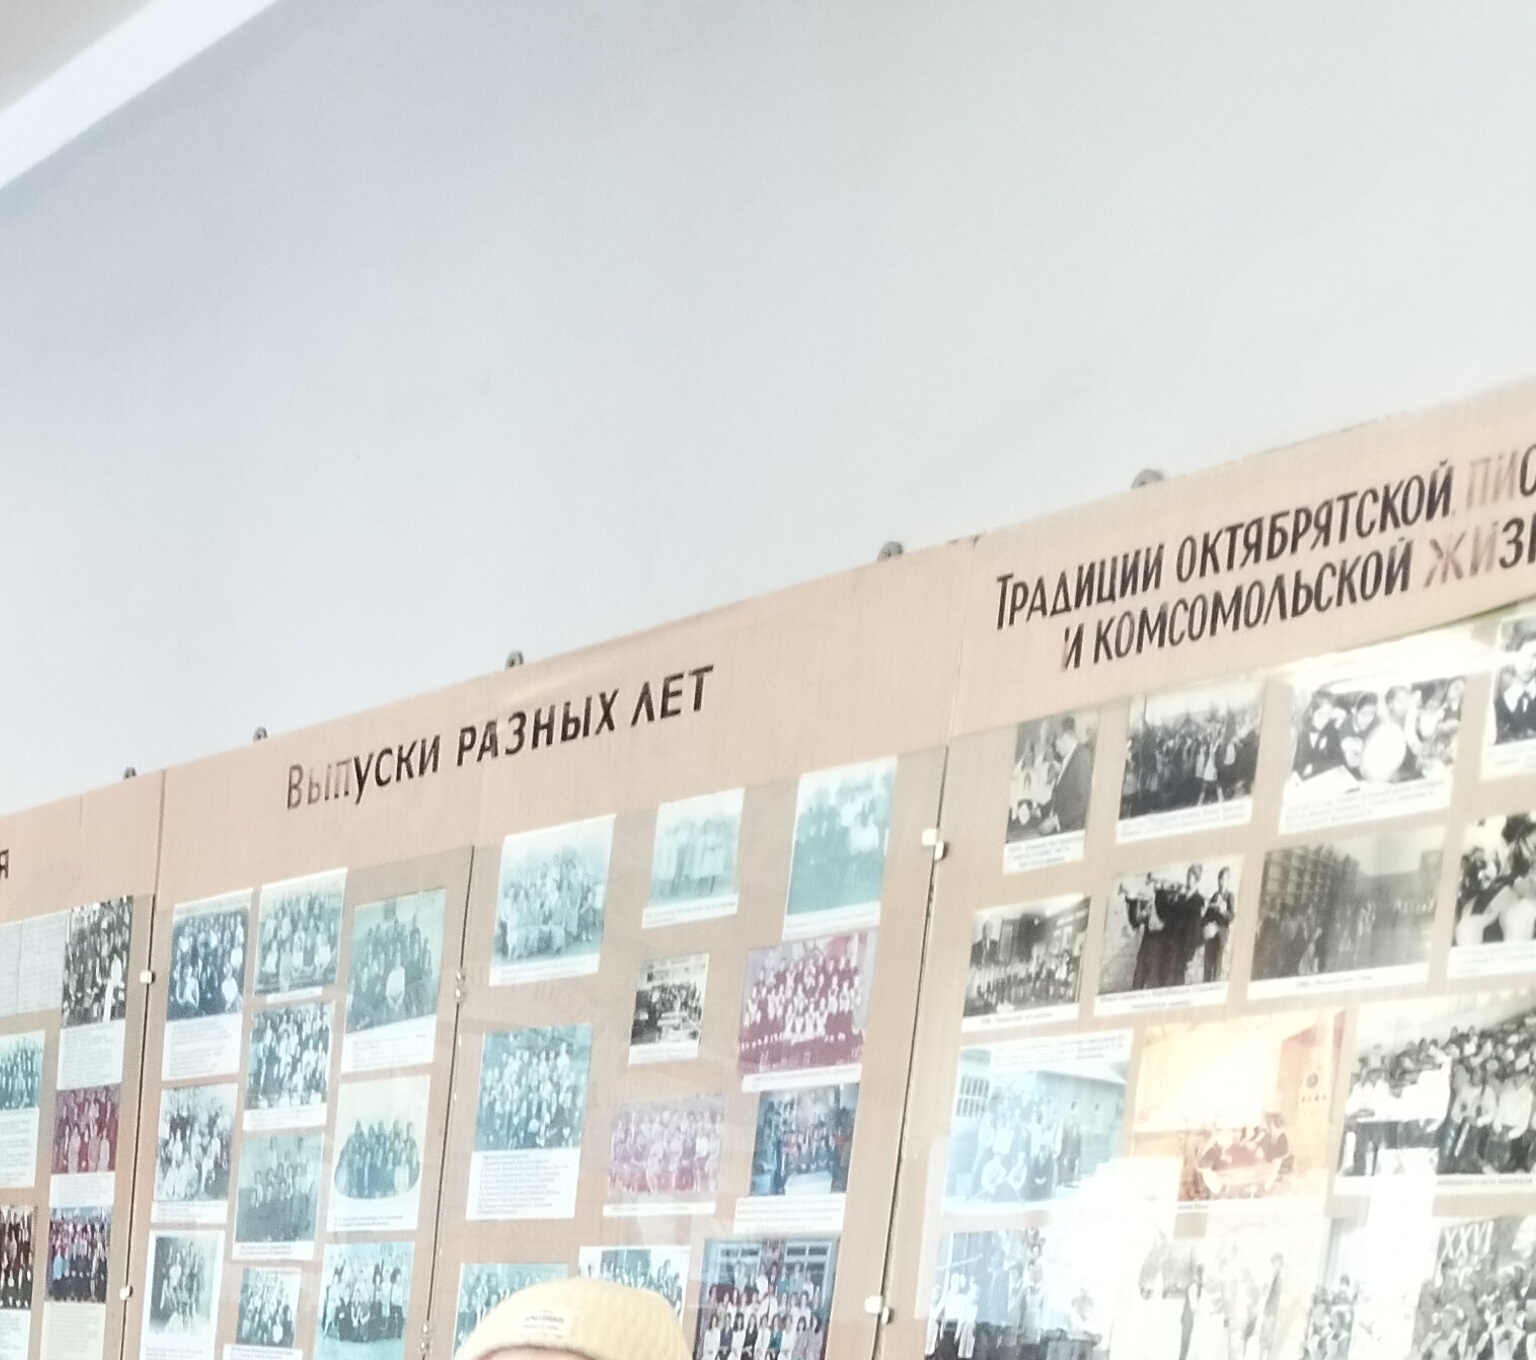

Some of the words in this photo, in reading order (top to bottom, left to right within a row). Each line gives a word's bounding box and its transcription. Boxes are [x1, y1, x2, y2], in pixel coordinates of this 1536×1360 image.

[996, 542, 1165, 630] ТРАДИЦИИ
[1061, 623, 1084, 672] И
[1093, 537, 1414, 664] КОМСОМОЛЬСКОЙ
[287, 735, 441, 810] ВЫПУСКИ
[457, 688, 620, 766] РАЗНЫХ
[631, 664, 714, 727] ЛЕТ
